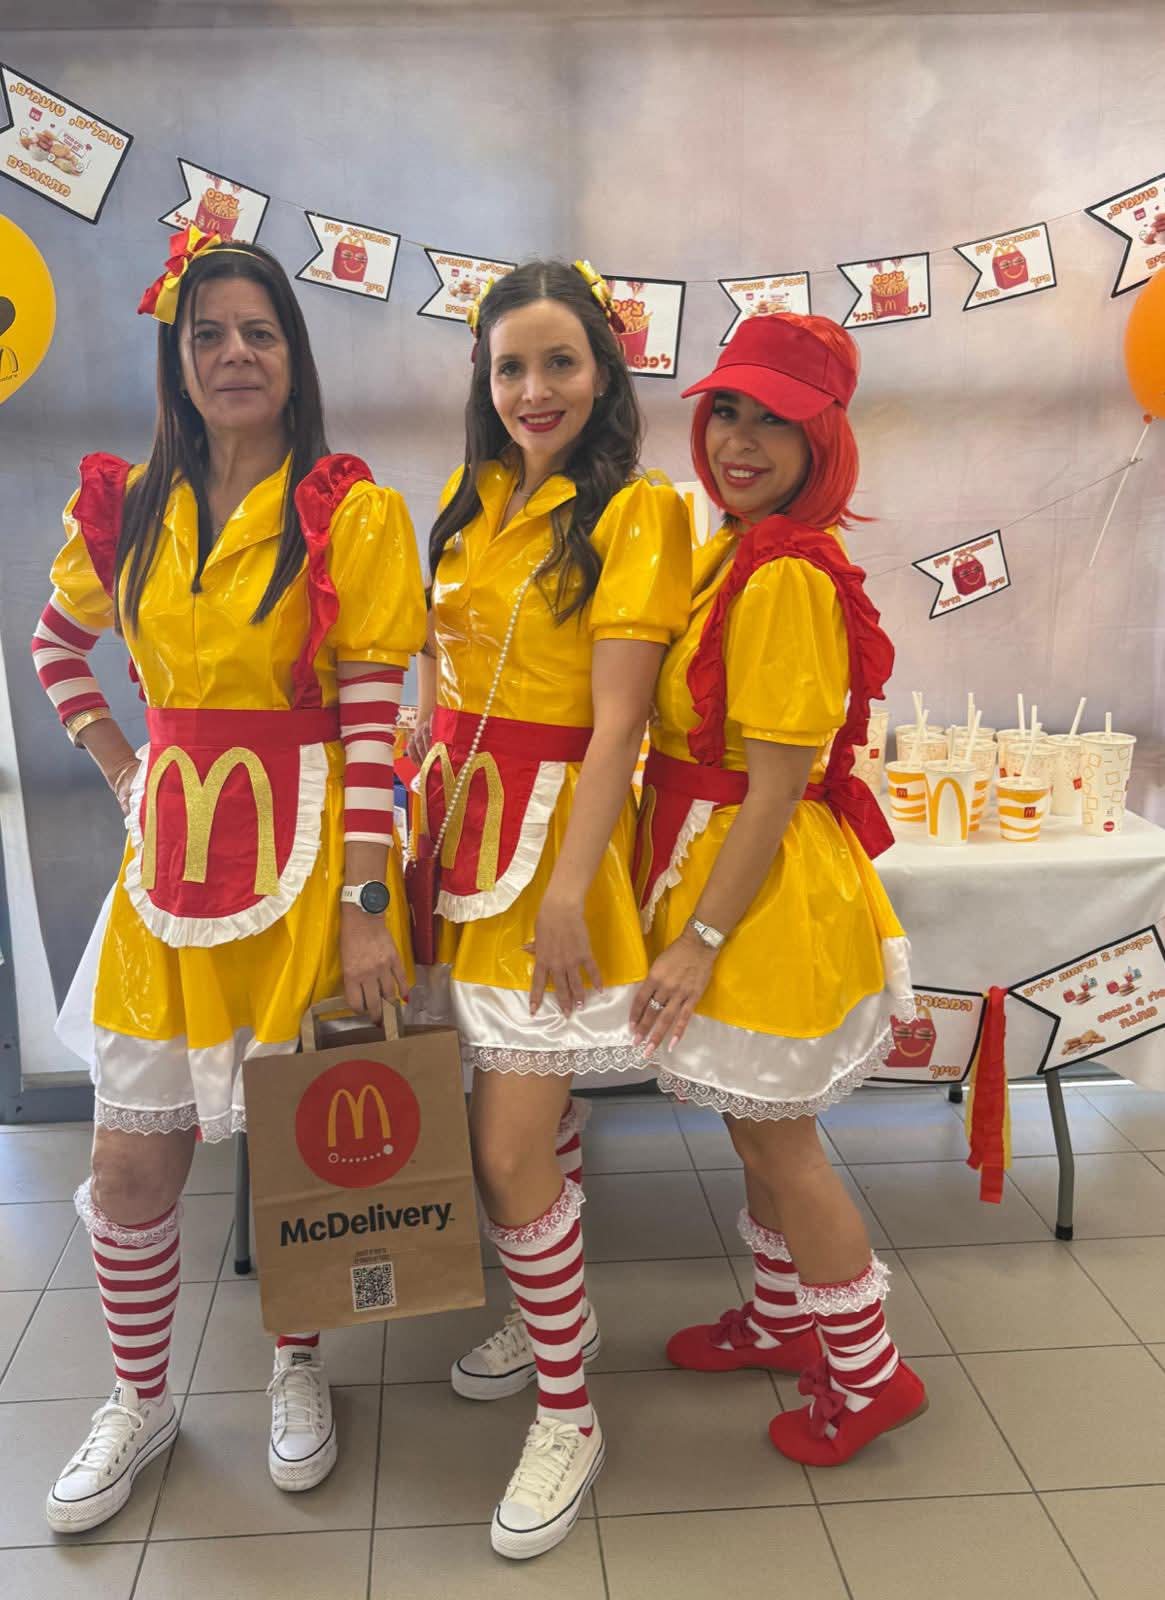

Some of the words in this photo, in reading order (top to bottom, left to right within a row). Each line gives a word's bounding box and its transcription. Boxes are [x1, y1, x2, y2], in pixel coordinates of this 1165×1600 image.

[7, 155, 71, 197] מתאהבים
[914, 993, 973, 1012] המבורג
[280, 1203, 451, 1246] McDelivery
